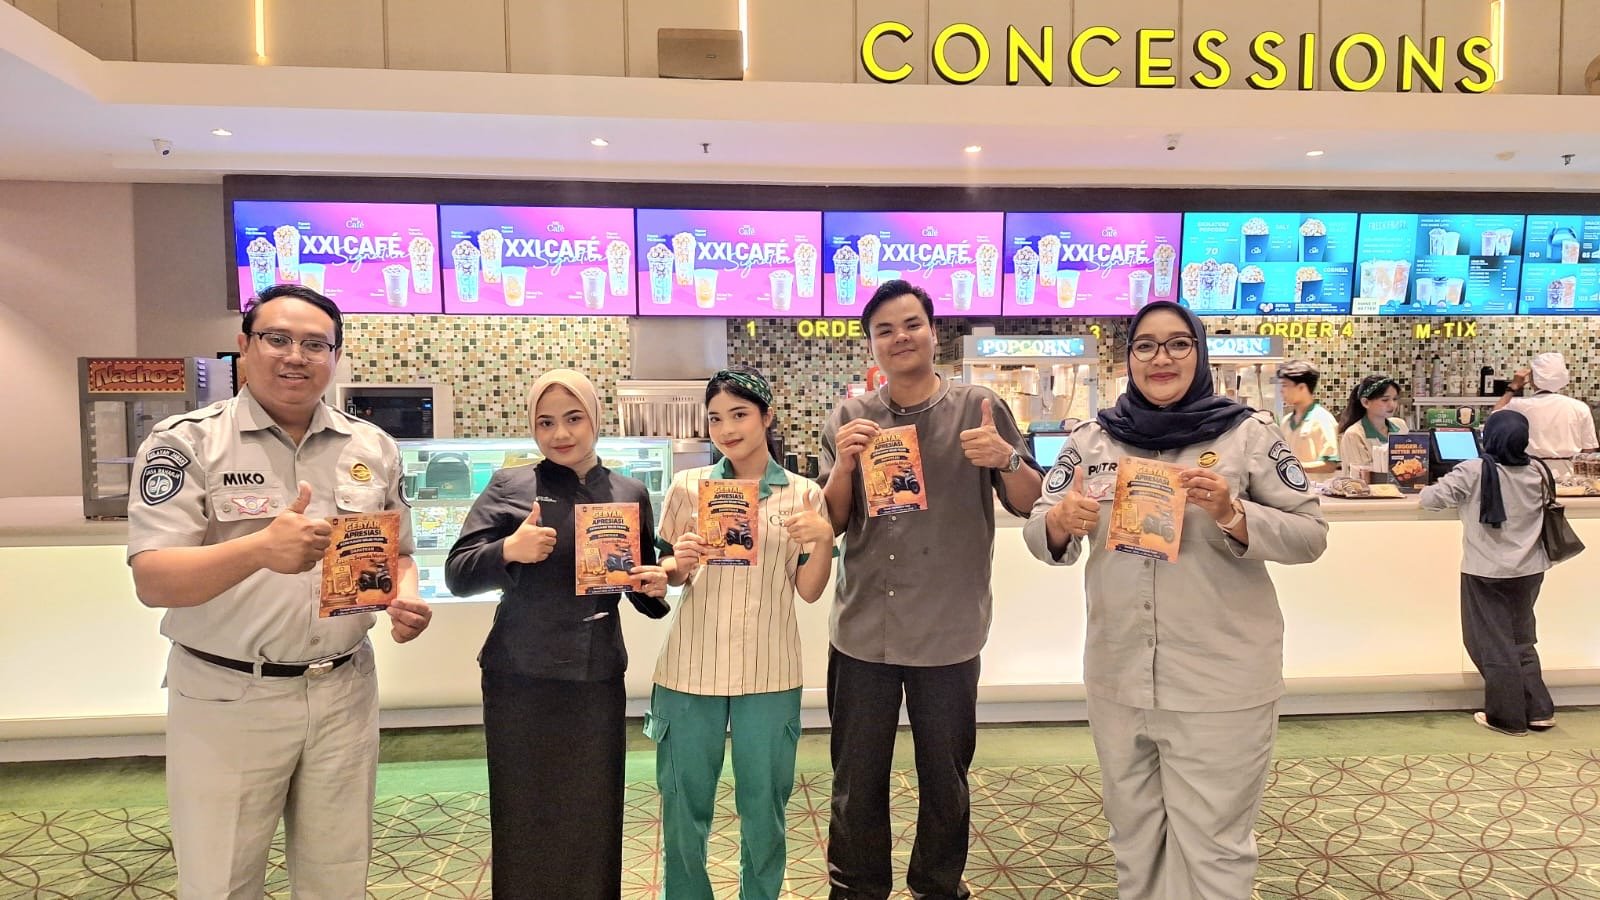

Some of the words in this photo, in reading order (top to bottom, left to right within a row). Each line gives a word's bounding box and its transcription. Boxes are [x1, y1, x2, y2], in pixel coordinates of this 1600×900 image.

[860, 21, 1497, 93] CONCESSIONS
[302, 235, 339, 254] XXI
[344, 232, 403, 254] CAFÉ
[505, 238, 540, 257] XXI
[544, 236, 601, 258] CAFÉ
[698, 242, 732, 260] XXI
[735, 238, 789, 260] CAFÉ
[881, 244, 914, 262] XXI
[918, 240, 971, 262] CAFÉ
[1061, 244, 1094, 262] XXI
[1098, 240, 1149, 262] CAFÉ
[747, 321, 756, 337] 1
[798, 320, 867, 337] ORDE
[1259, 321, 1333, 338] ORDER
[1341, 321, 1354, 337] 4
[1415, 322, 1477, 339] M-TIX
[982, 339, 1071, 354] POPCORN
[95, 364, 180, 388] Nachos
[223, 472, 265, 487] MIKO
[344, 530, 382, 539] APRESIASI
